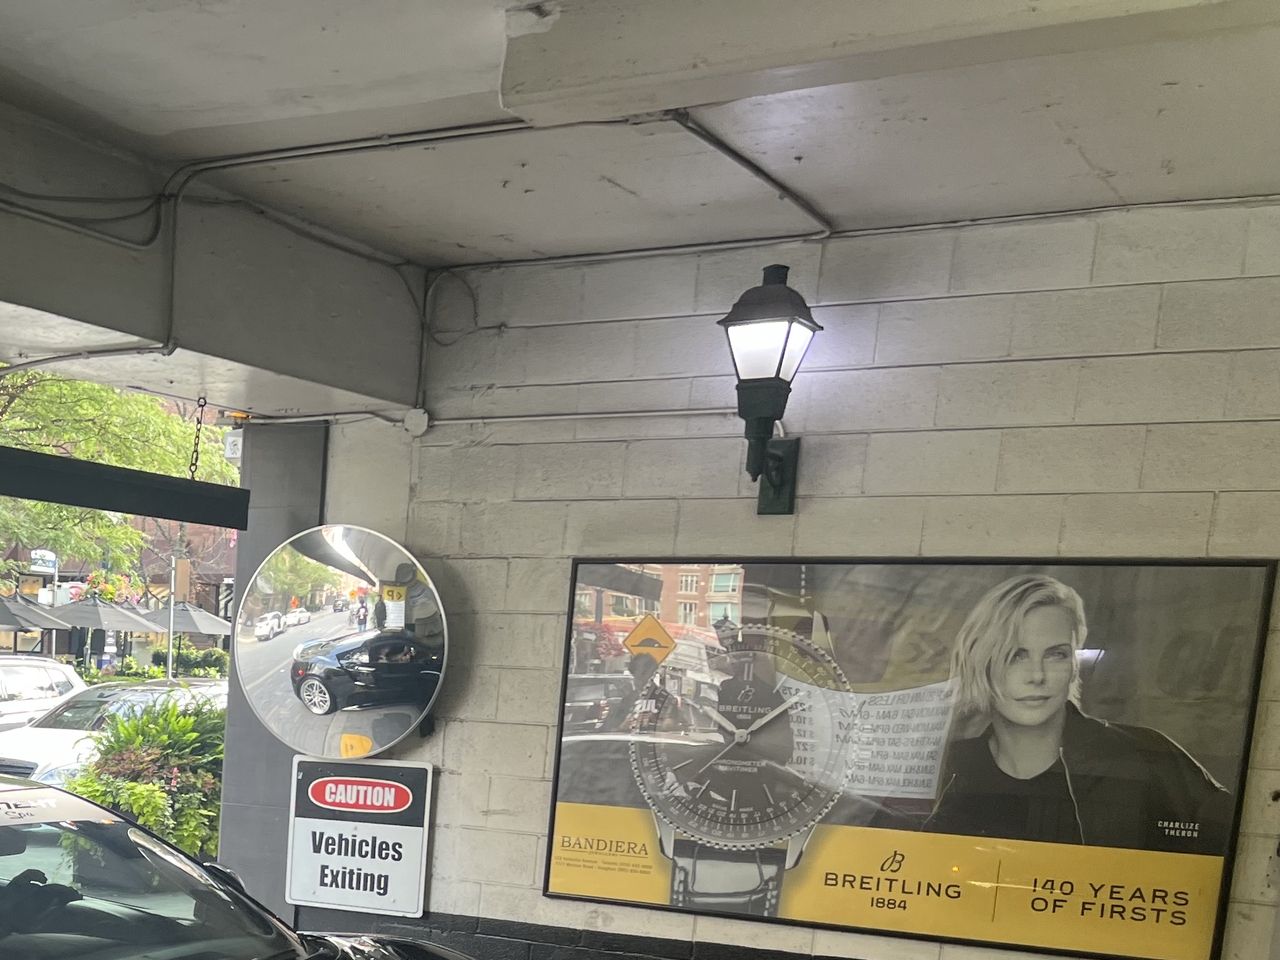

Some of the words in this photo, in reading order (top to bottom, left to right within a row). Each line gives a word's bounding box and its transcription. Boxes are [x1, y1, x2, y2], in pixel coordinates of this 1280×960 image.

[719, 705, 771, 714] BREITLING
[324, 783, 395, 807] CAUTION
[5, 811, 36, 820] Spa
[1157, 820, 1200, 830] CHARLIZE
[1164, 829, 1199, 838] THERON
[311, 831, 403, 861] Vehicles
[560, 835, 649, 855] BANDIERA
[319, 864, 389, 896] Exiting
[824, 872, 962, 899] BREITLING
[1033, 878, 1074, 896] 140
[1089, 882, 1190, 907] YEARS
[870, 897, 907, 911] 1884
[1031, 897, 1068, 913] OF
[1080, 901, 1187, 926] FIRSTS
